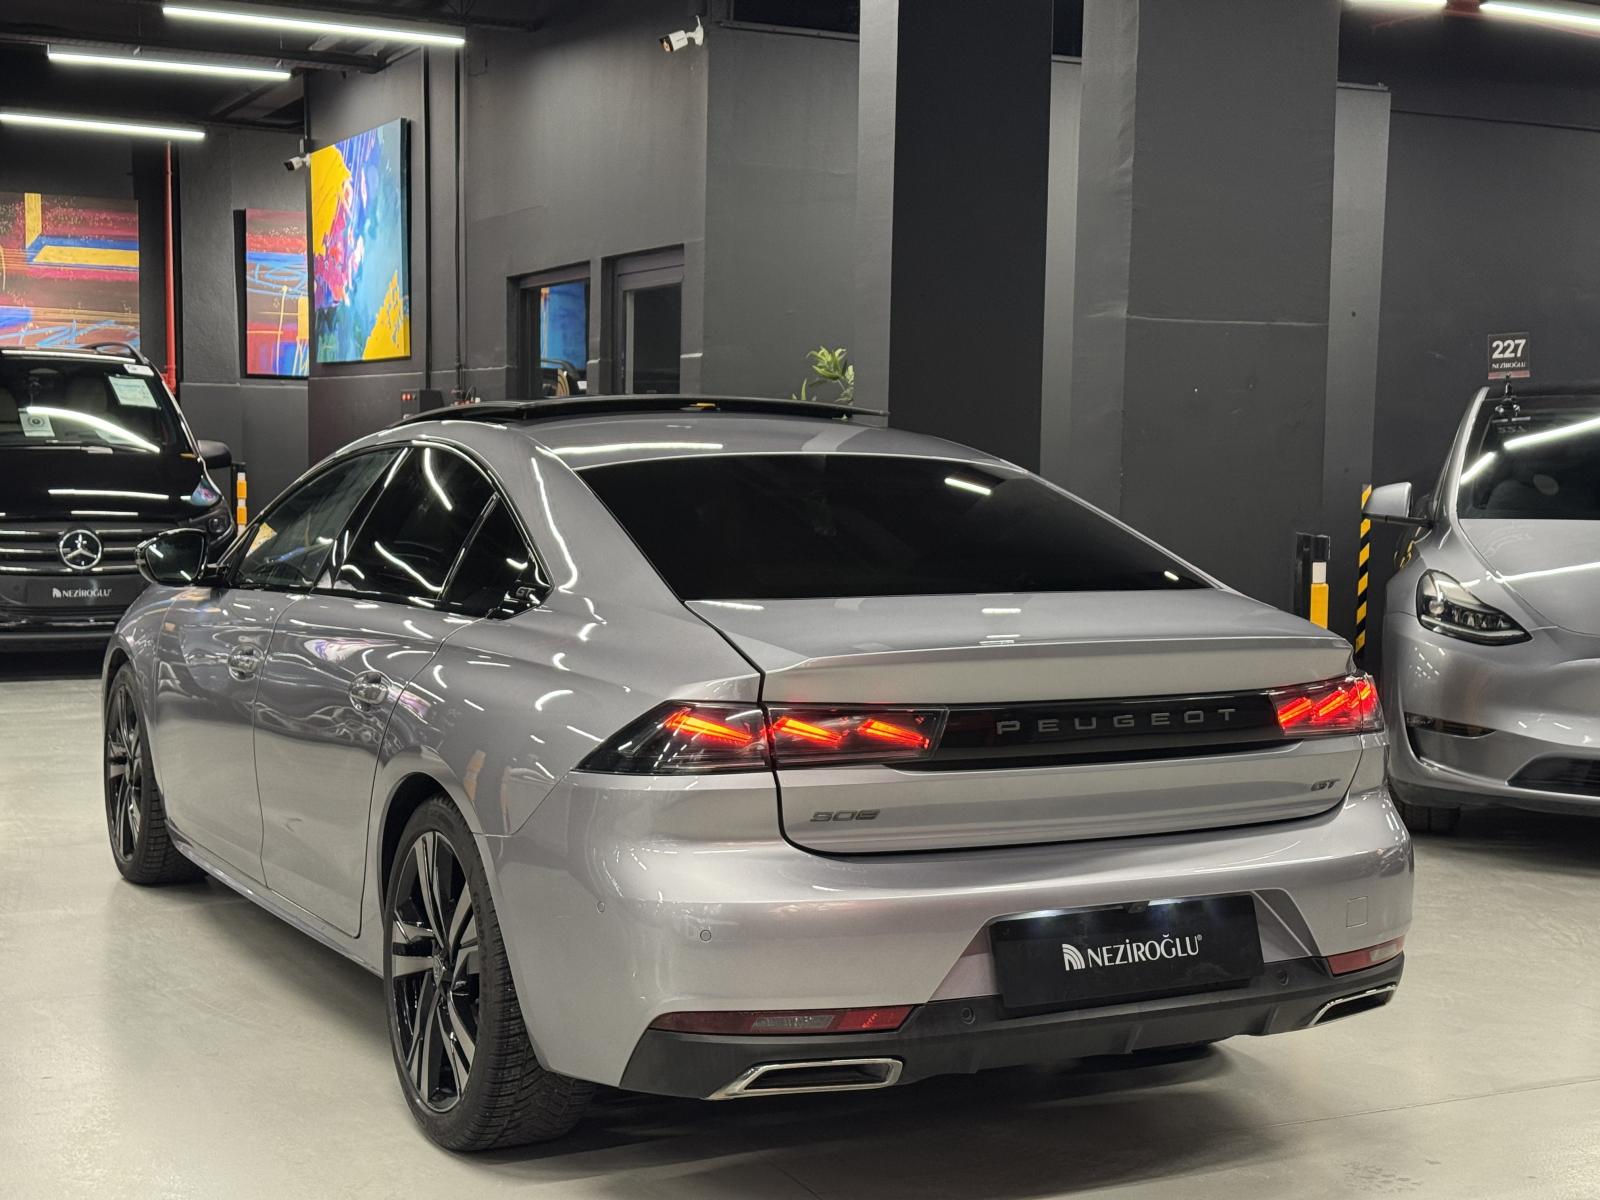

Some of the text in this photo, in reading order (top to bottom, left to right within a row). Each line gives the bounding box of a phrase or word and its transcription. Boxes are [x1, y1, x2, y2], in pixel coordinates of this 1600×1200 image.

[1492, 338, 1526, 359] 227
[996, 708, 1236, 735] PEUGEOT
[1310, 778, 1341, 791] GT
[809, 808, 881, 822] 508
